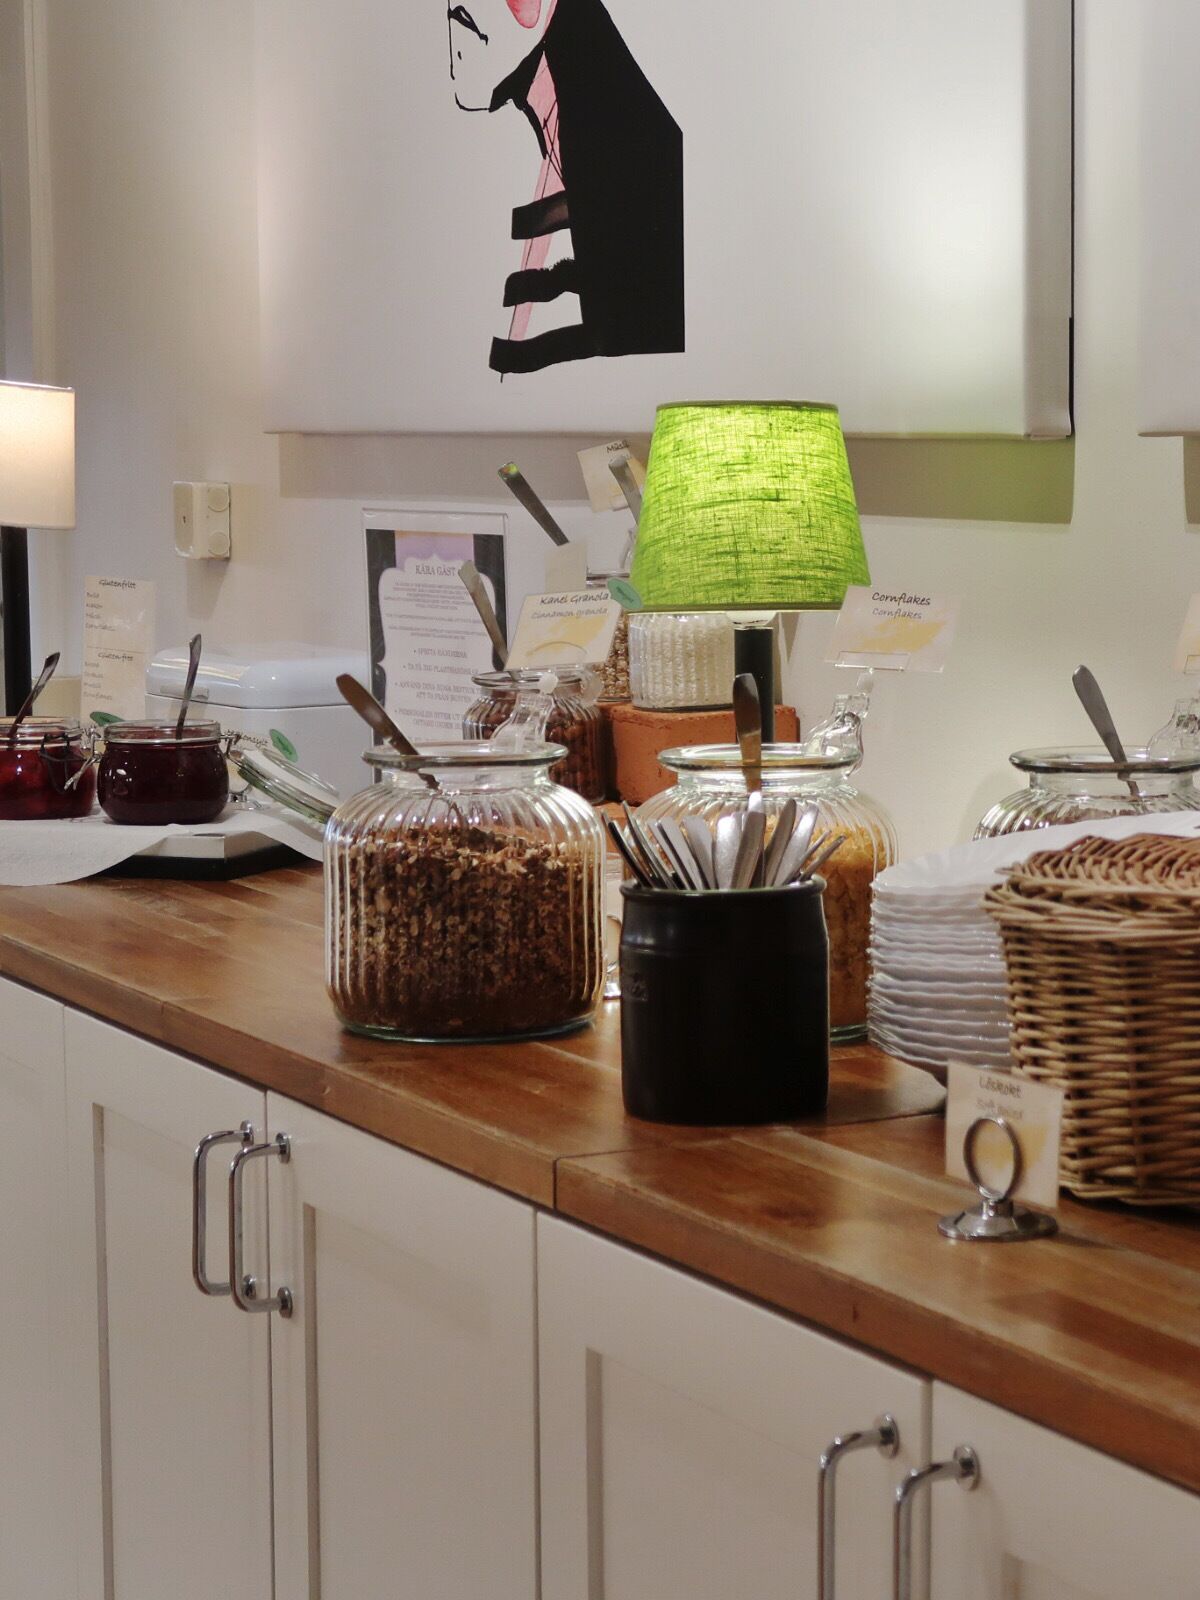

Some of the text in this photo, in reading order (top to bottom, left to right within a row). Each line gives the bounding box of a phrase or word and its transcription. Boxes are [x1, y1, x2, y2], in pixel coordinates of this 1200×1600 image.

[415, 563, 456, 577] KÄRA GÄST
[98, 579, 137, 590] Glutenfritt
[540, 592, 609, 605] Kanel Granola
[872, 591, 931, 607] Cornflakes
[872, 607, 922, 620] Cornflakes
